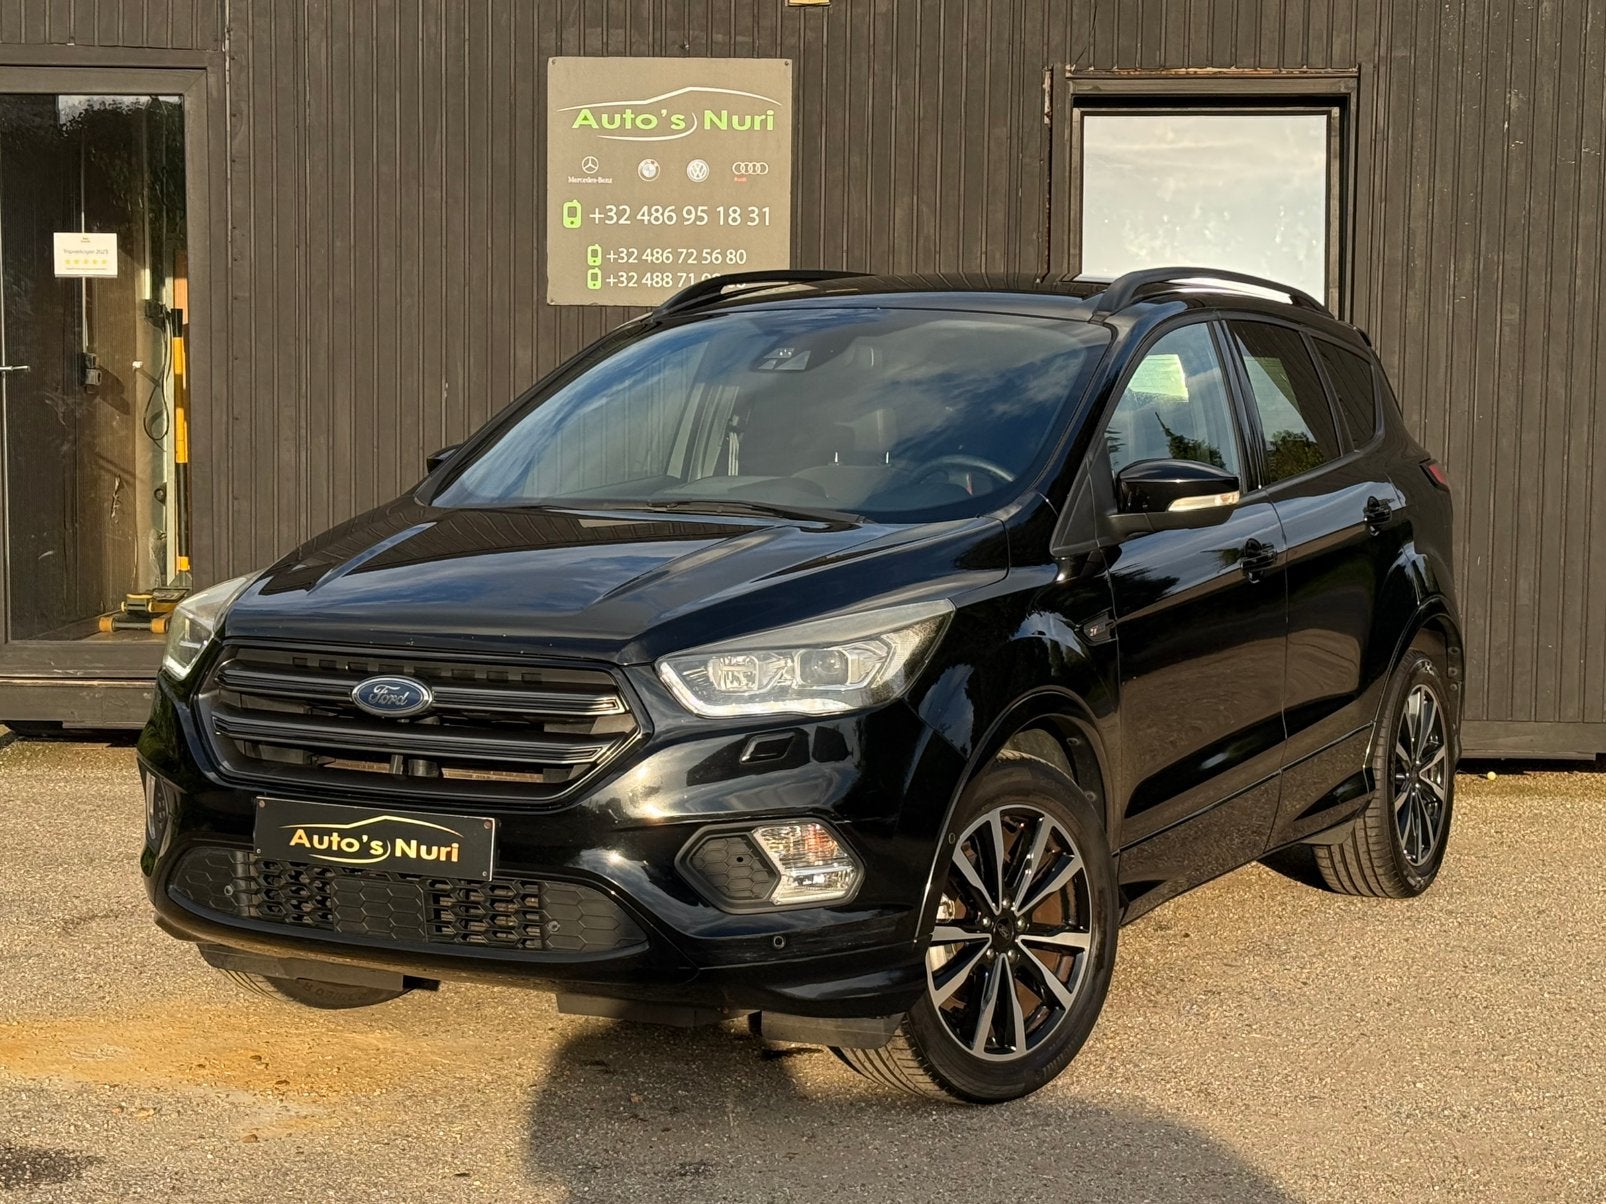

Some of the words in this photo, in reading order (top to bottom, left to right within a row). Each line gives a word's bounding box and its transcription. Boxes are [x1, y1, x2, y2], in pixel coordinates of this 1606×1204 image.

[572, 109, 686, 130] Auto's
[703, 110, 775, 131] Nuri
[589, 205, 631, 225] +32
[636, 205, 677, 225] 486
[682, 206, 708, 225] 95
[716, 206, 741, 226] 18
[747, 206, 770, 226] 31
[606, 248, 638, 264] +32
[641, 248, 673, 264] 486
[677, 249, 697, 264] 72
[701, 249, 722, 265] 56
[726, 249, 747, 265] 80
[606, 272, 638, 288] +32
[641, 272, 673, 288] 488
[677, 272, 695, 288] 71
[368, 684, 410, 706] Ford
[289, 828, 384, 856] Auto's
[395, 838, 460, 862] Nuri
